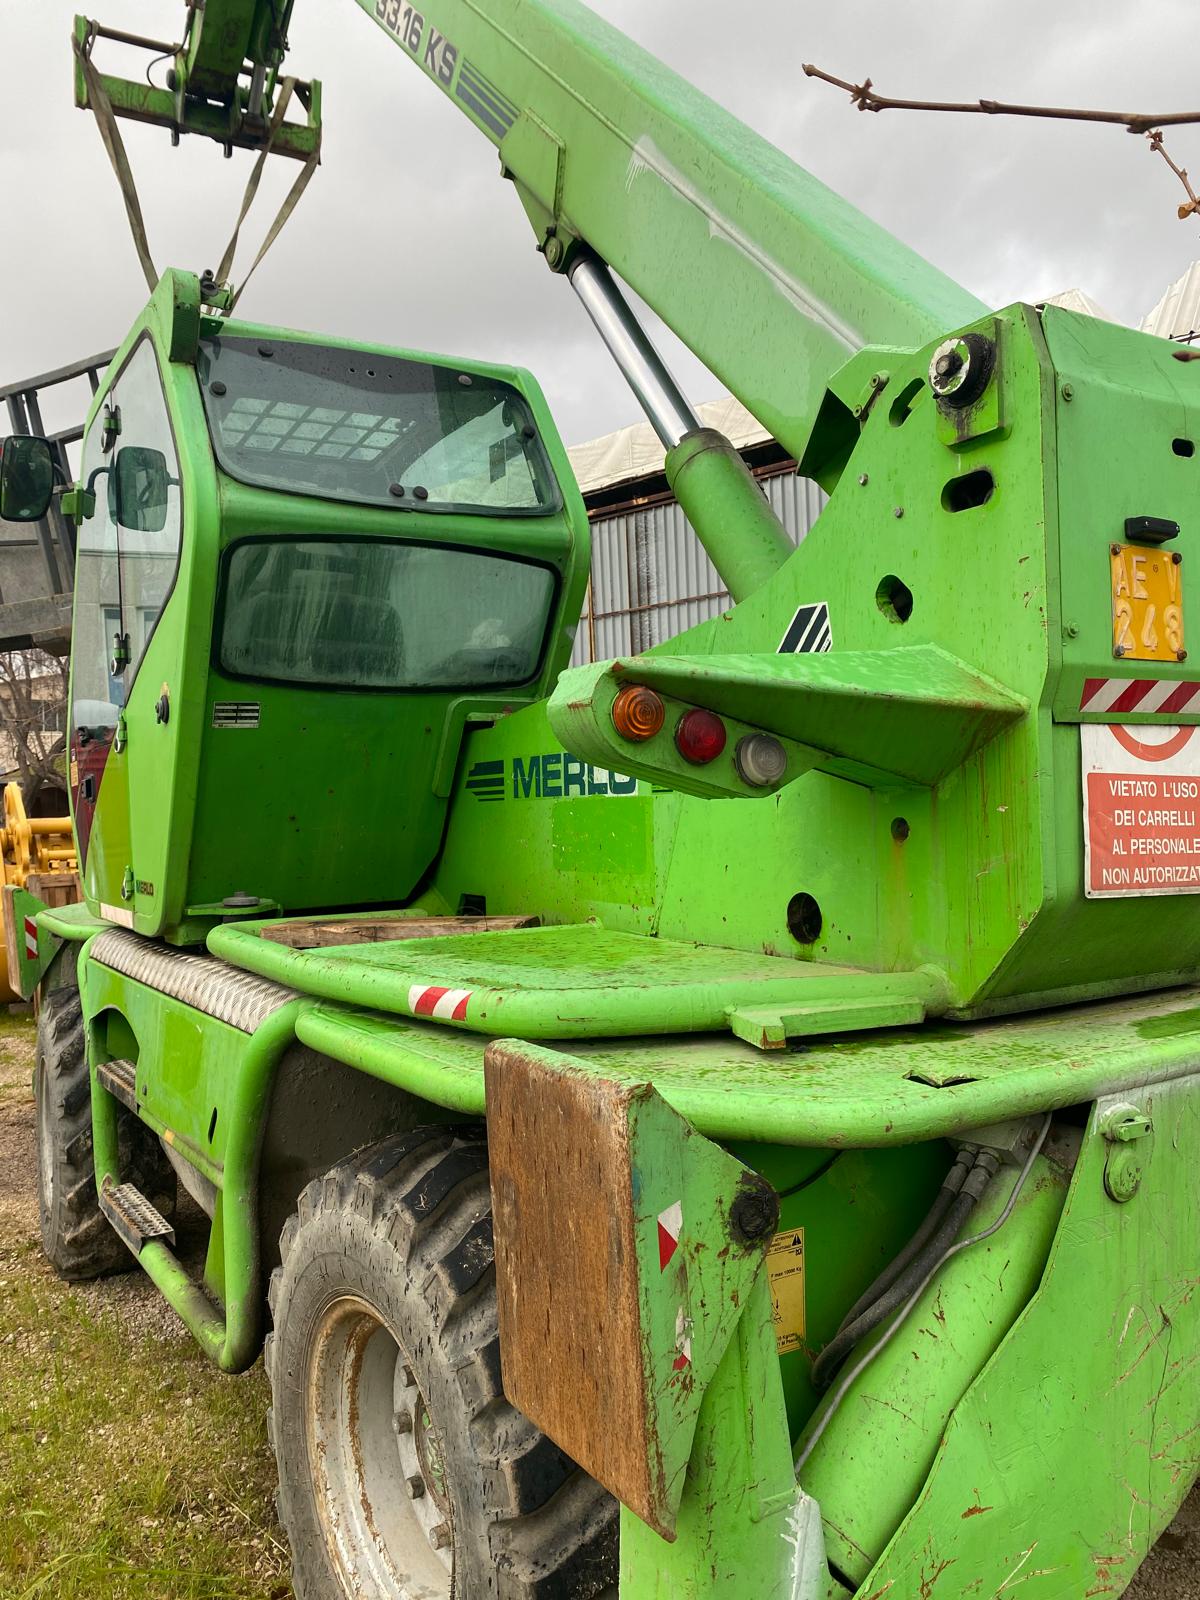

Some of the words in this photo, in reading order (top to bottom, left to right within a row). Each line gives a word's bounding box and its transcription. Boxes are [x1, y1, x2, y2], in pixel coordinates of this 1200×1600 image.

[375, 0, 424, 53] 33.16
[424, 27, 457, 86] KS
[1115, 553, 1149, 600] AE
[1115, 599, 1183, 653] 248
[1109, 780, 1157, 798] VIETATO
[1163, 782, 1198, 798] L'USO
[1114, 810, 1135, 826] DEI
[1138, 810, 1195, 827] CARRELLI
[1112, 839, 1128, 855] AL
[1103, 867, 1130, 885] NON
